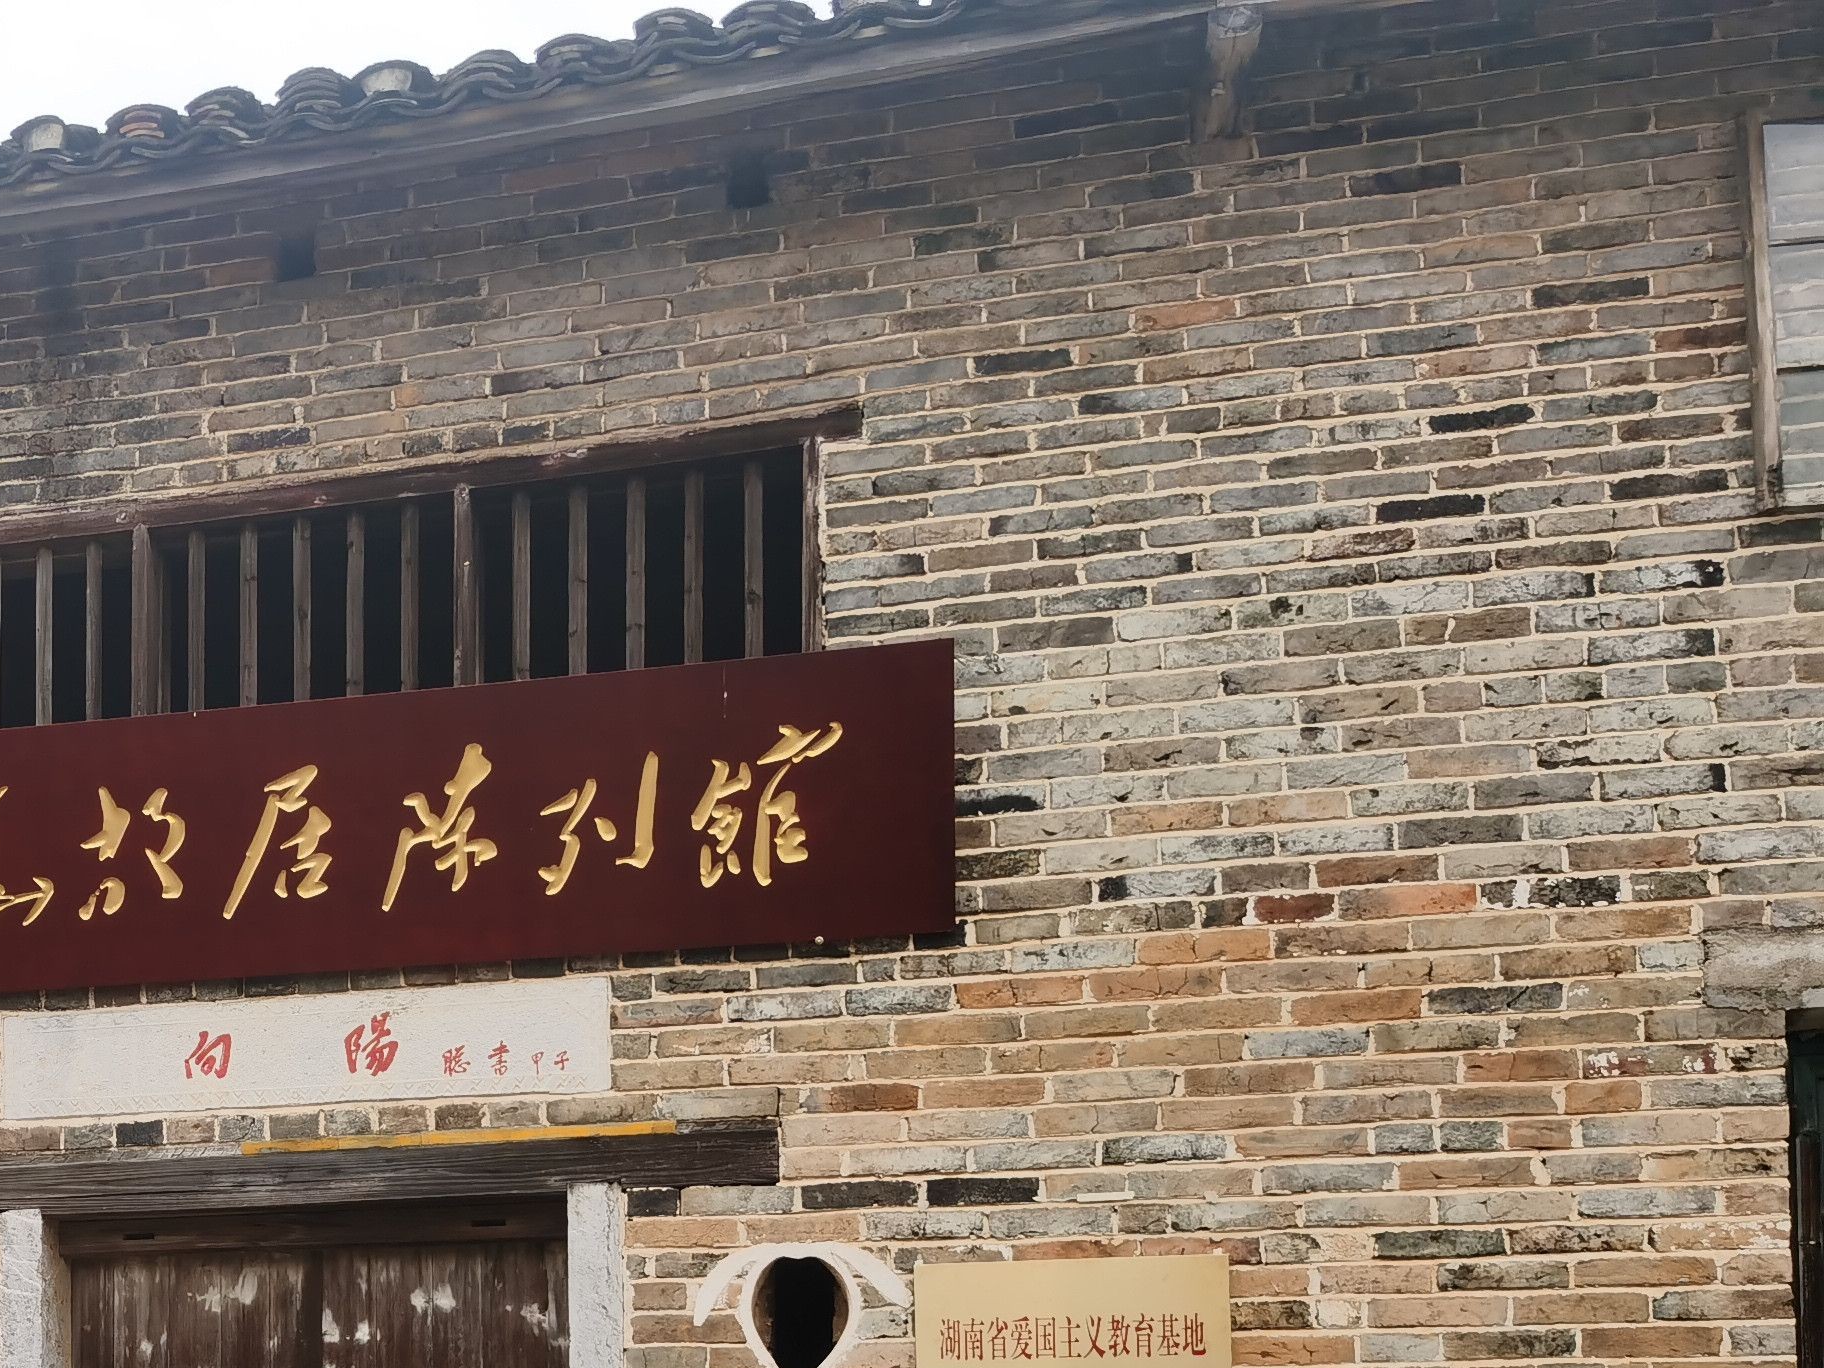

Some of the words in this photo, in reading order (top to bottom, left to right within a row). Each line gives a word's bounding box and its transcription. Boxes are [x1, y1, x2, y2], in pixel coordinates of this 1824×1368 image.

[939, 1312, 1208, 1361] 湖南省爱国主义教育基地
